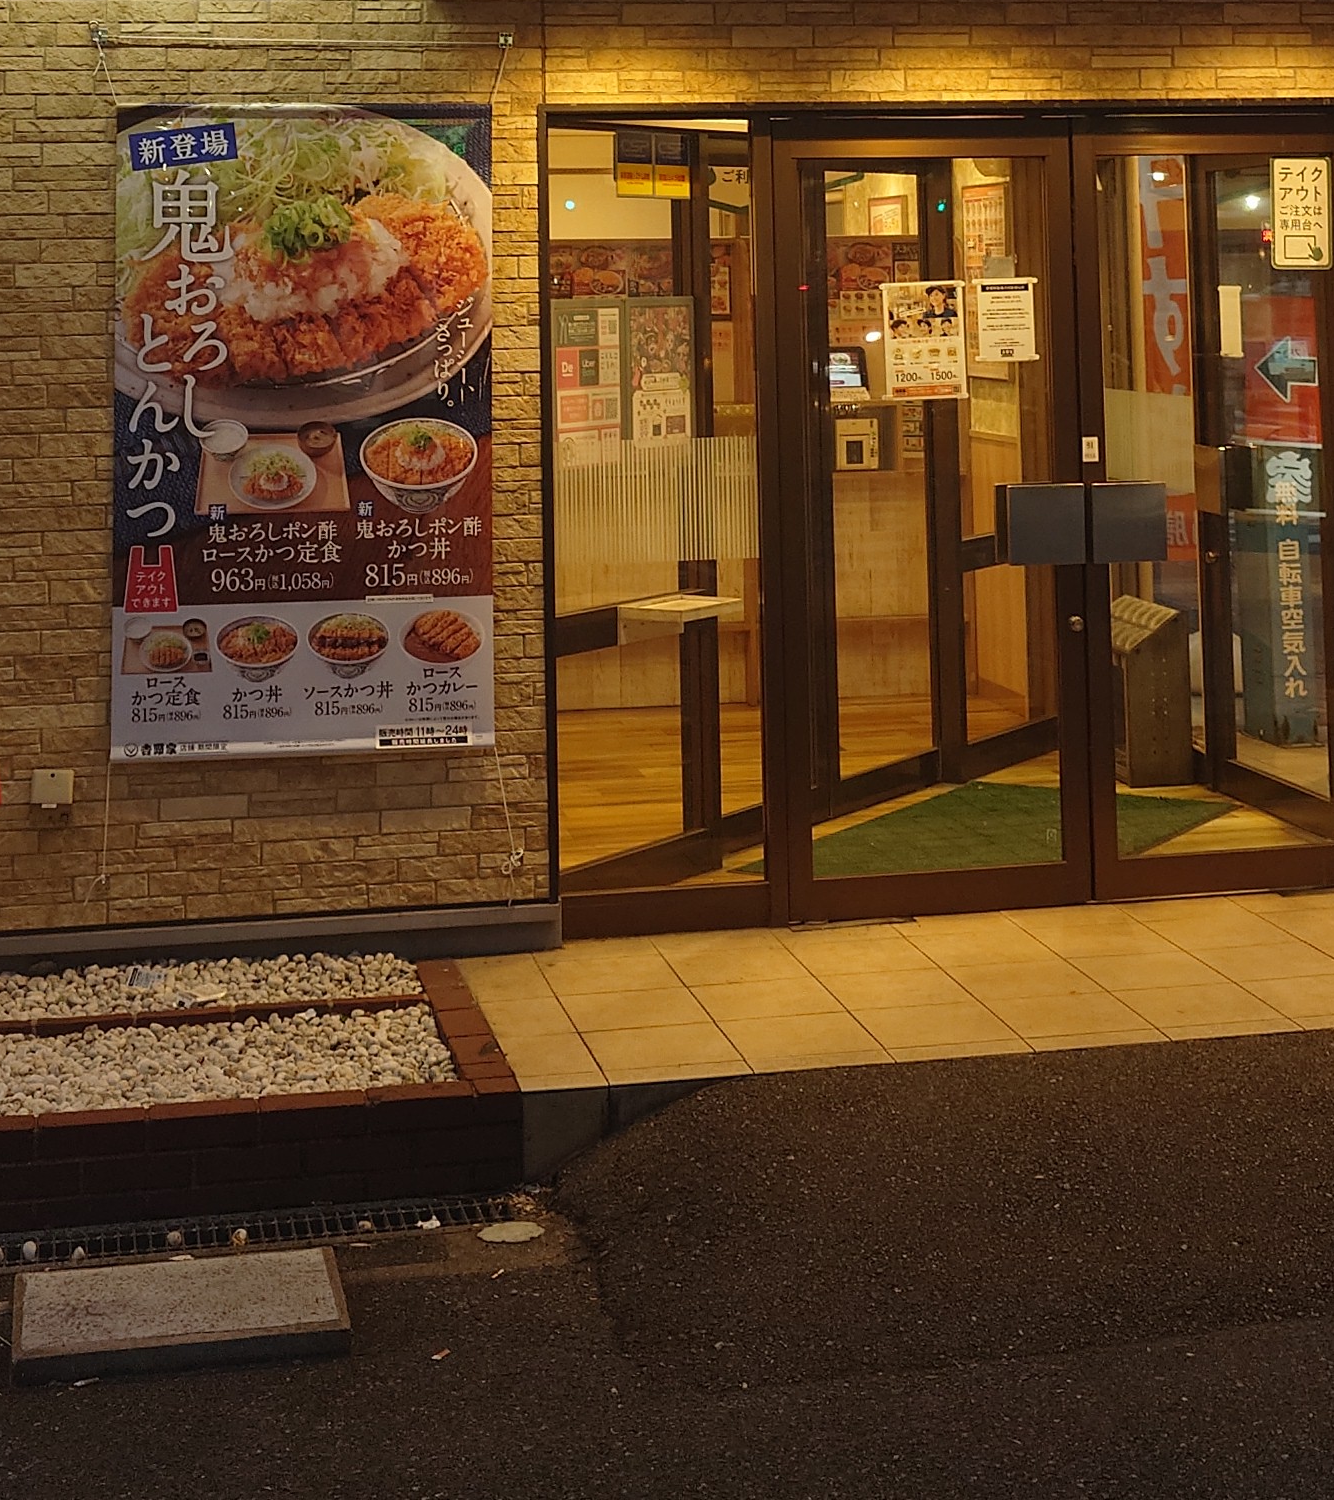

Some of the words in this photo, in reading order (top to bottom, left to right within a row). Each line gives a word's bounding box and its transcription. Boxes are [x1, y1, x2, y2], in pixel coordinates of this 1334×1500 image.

[138, 129, 231, 166] 新登場
[1278, 166, 1323, 182] テイク
[1278, 186, 1323, 202] アウト
[1278, 204, 1323, 217] ご注文は
[1279, 219, 1323, 231] 専用台へ
[141, 169, 236, 439] 鬼おろし
[433, 323, 455, 407] さっぱり。
[126, 313, 181, 538] とんかつ
[209, 505, 226, 521] 新
[357, 501, 373, 517] 新
[207, 520, 339, 544] 鬼おろしポン酢
[355, 516, 482, 540] 鬼おろしポン酢
[202, 541, 343, 564] ロースかつ定食
[387, 537, 451, 561] かつ丼
[135, 571, 167, 583] テイク
[135, 584, 166, 595] アウト
[131, 597, 172, 609] できます
[1277, 538, 1308, 699] 自転車空気入れ
[423, 667, 463, 679] ロース
[146, 676, 187, 689] ロース
[303, 681, 394, 700] ソースかつ丼
[406, 680, 479, 696] かつカレー
[131, 688, 202, 707] かつ定食
[232, 685, 283, 703] かつ丼
